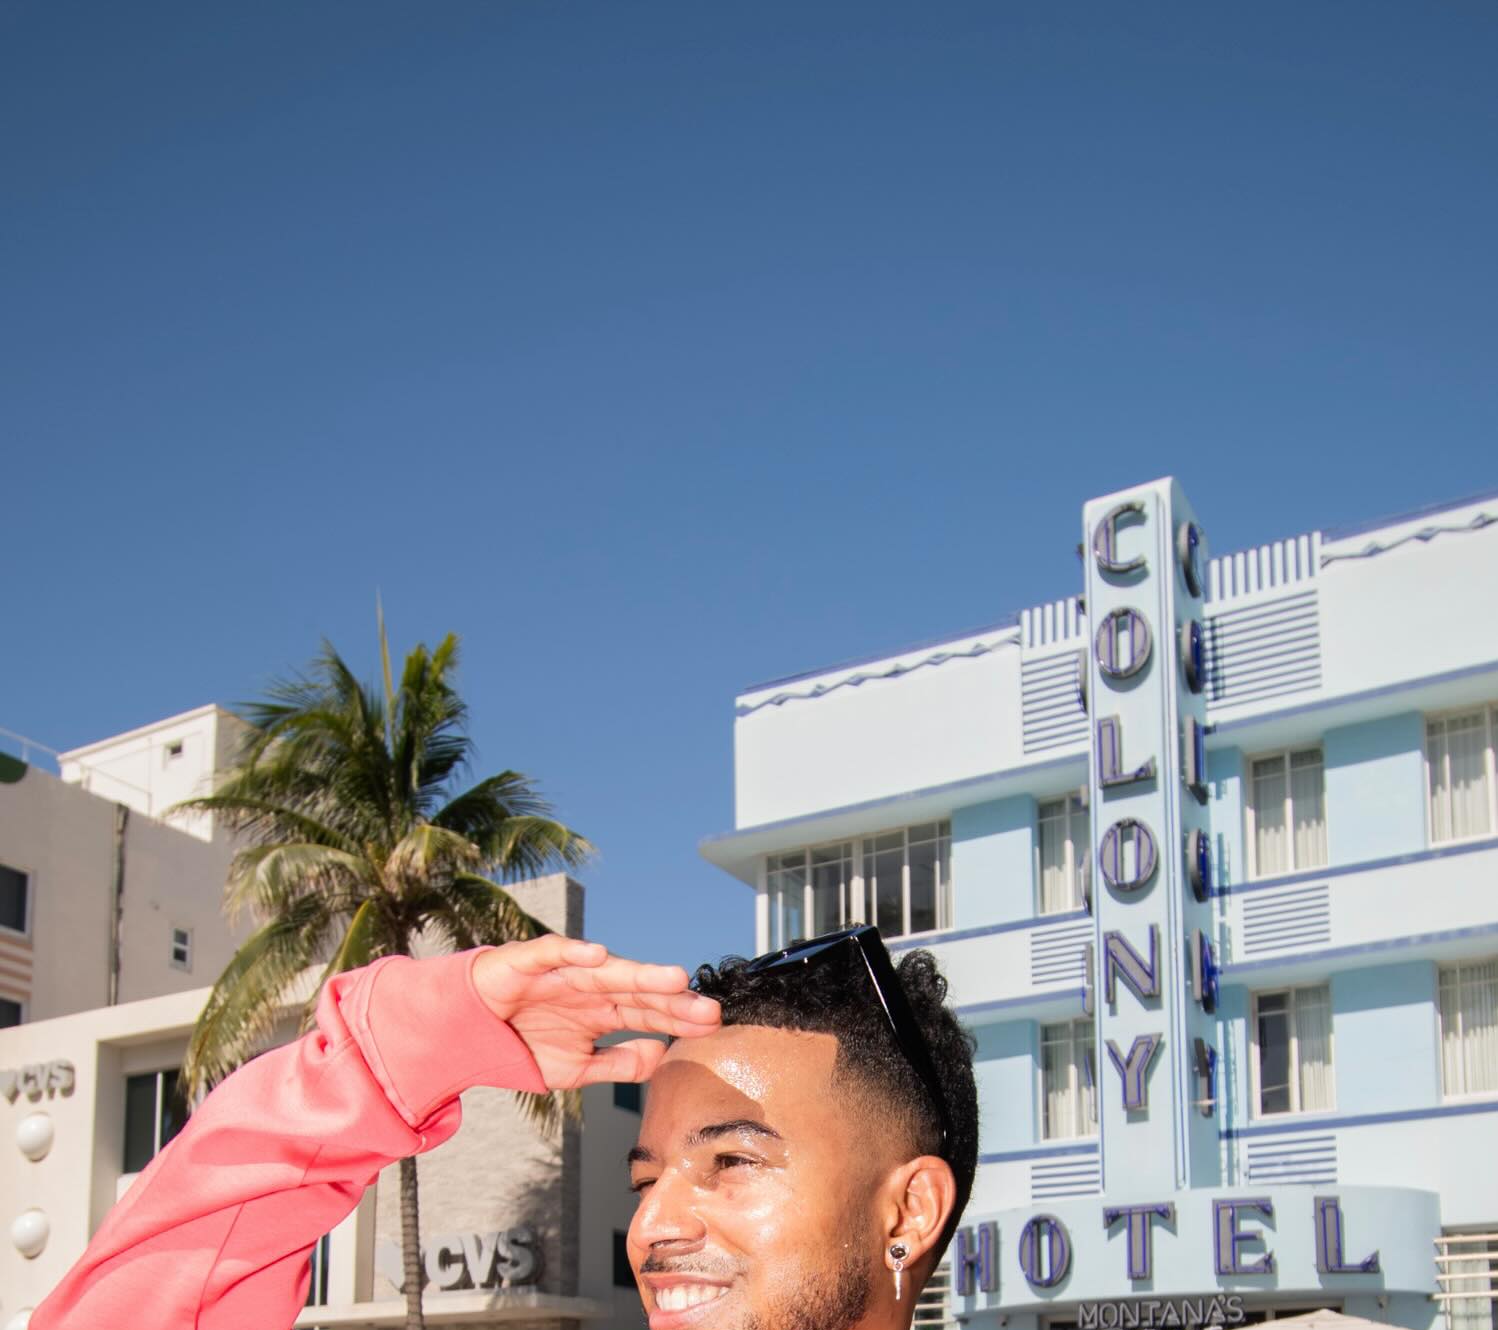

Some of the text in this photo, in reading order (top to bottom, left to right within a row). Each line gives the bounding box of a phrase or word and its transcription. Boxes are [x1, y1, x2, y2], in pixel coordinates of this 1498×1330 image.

[1094, 501, 1163, 1110] COLONY
[16, 1059, 75, 1093] CVS
[424, 1226, 535, 1288] CVS
[956, 1196, 1381, 1297] HOTEL
[1078, 1295, 1245, 1328] MONTANA'S
